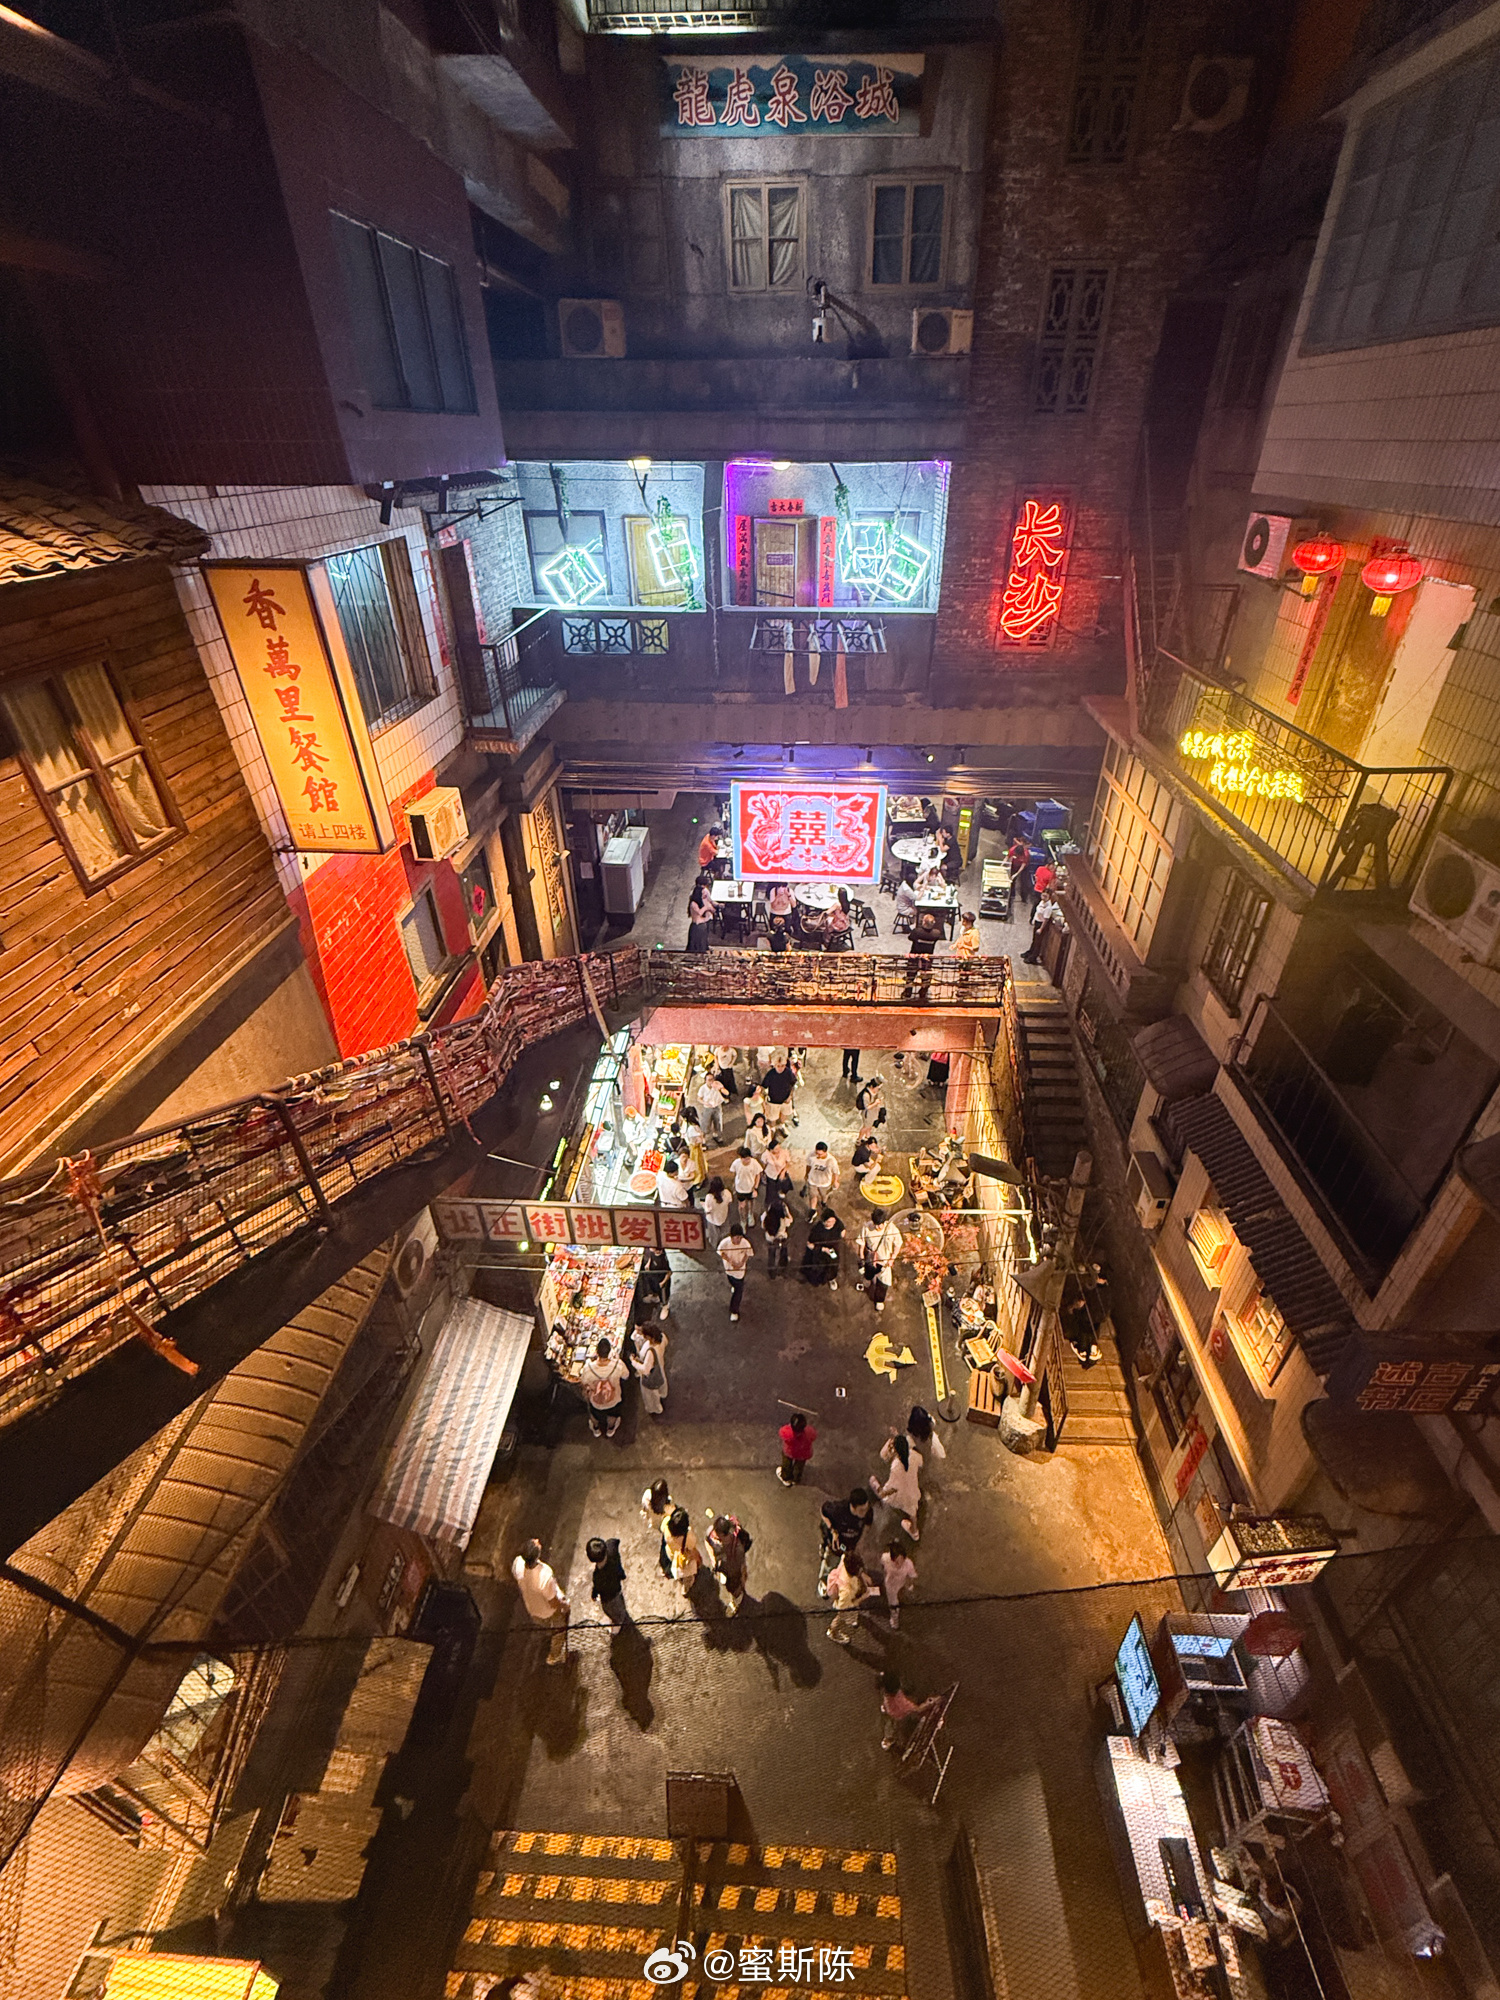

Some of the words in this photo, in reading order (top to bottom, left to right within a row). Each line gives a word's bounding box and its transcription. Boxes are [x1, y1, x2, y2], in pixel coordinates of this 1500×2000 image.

[672, 64, 900, 128] 龍虎泉浴城
[1000, 500, 1065, 639] 长沙
[243, 579, 340, 813] 香萬里餐館
[298, 823, 367, 841] 请上四楼
[443, 1210, 701, 1244] 北正街批发部
